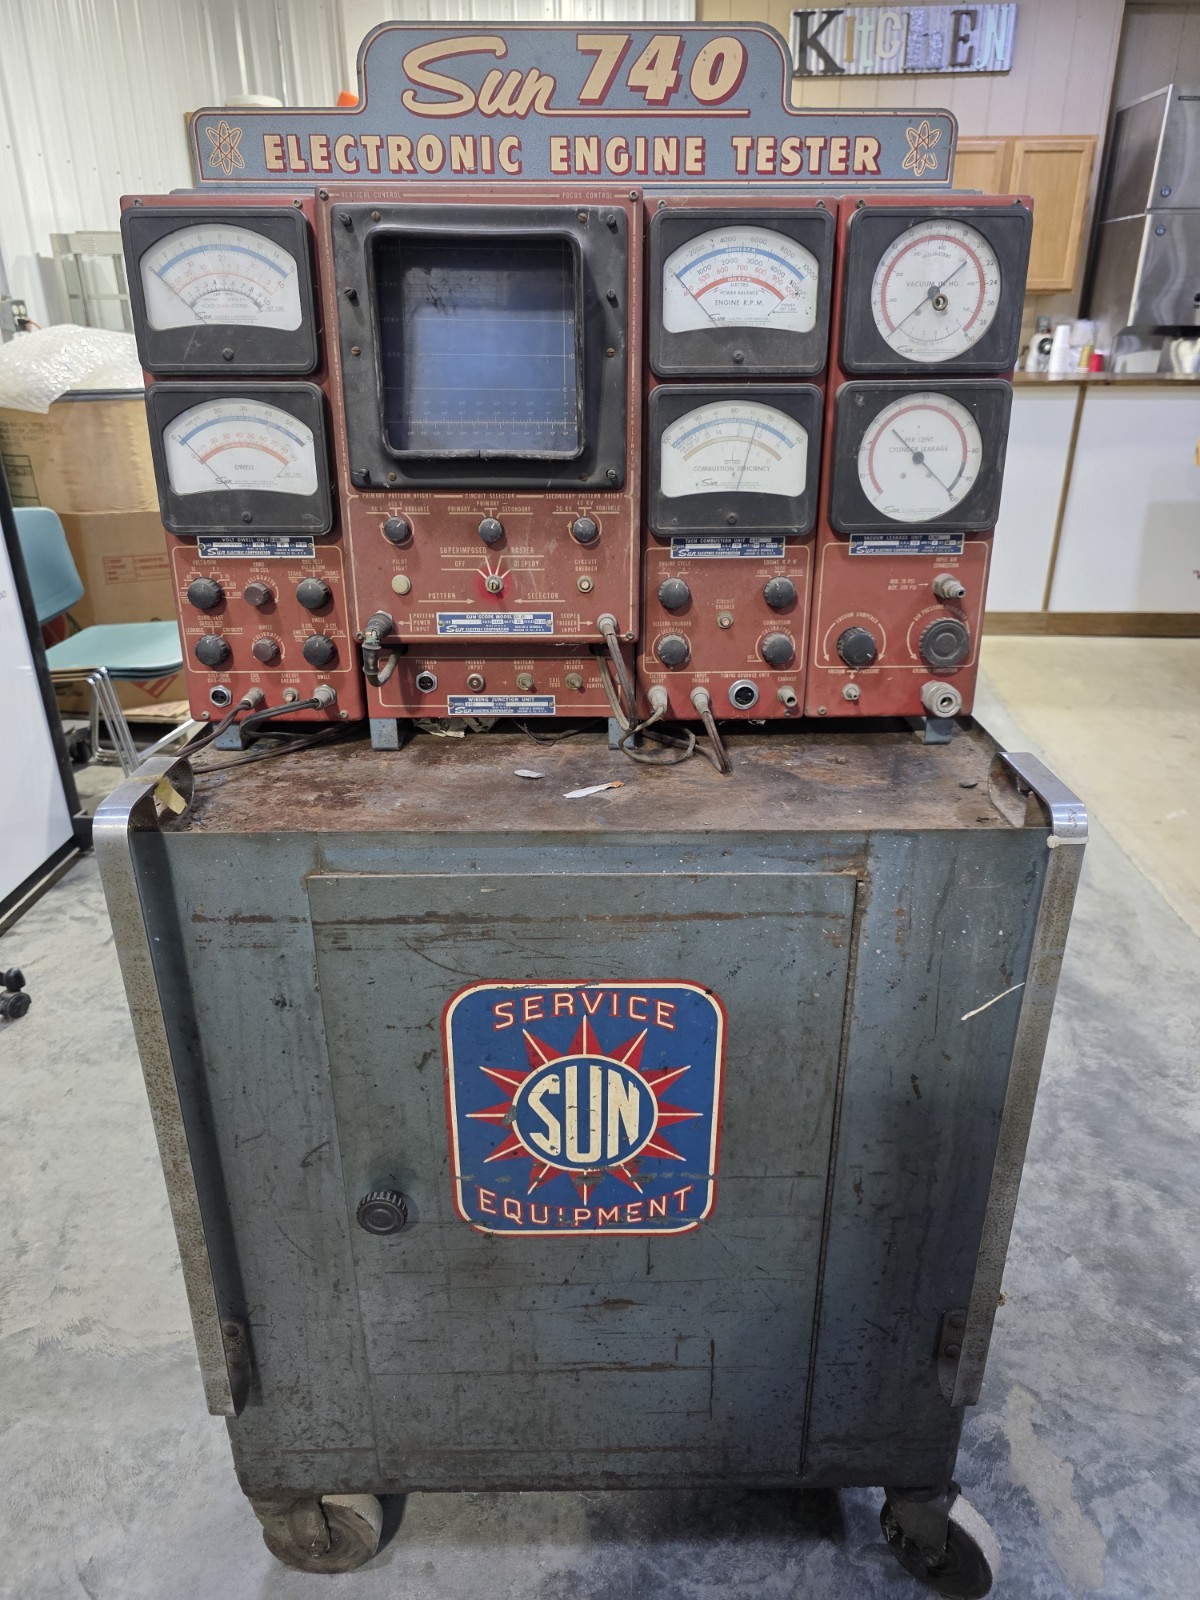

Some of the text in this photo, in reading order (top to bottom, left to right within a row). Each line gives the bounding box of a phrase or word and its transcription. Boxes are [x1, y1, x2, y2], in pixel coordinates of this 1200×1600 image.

[402, 33, 748, 119] Sun 740
[263, 134, 882, 175] ELECTRONIC ENGINE TESTER
[341, 191, 401, 199] VERTICAL CONTROL
[562, 191, 613, 199] FOCUS CONTROL
[750, 237, 768, 245] 6000
[698, 258, 786, 278] 1000 2000 3000 4000
[716, 266, 729, 274] 600
[446, 625, 465, 633] Sun
[493, 990, 677, 1031] SERVICE
[527, 1065, 640, 1163] SUN
[476, 1184, 693, 1226] EQUIPMENT
